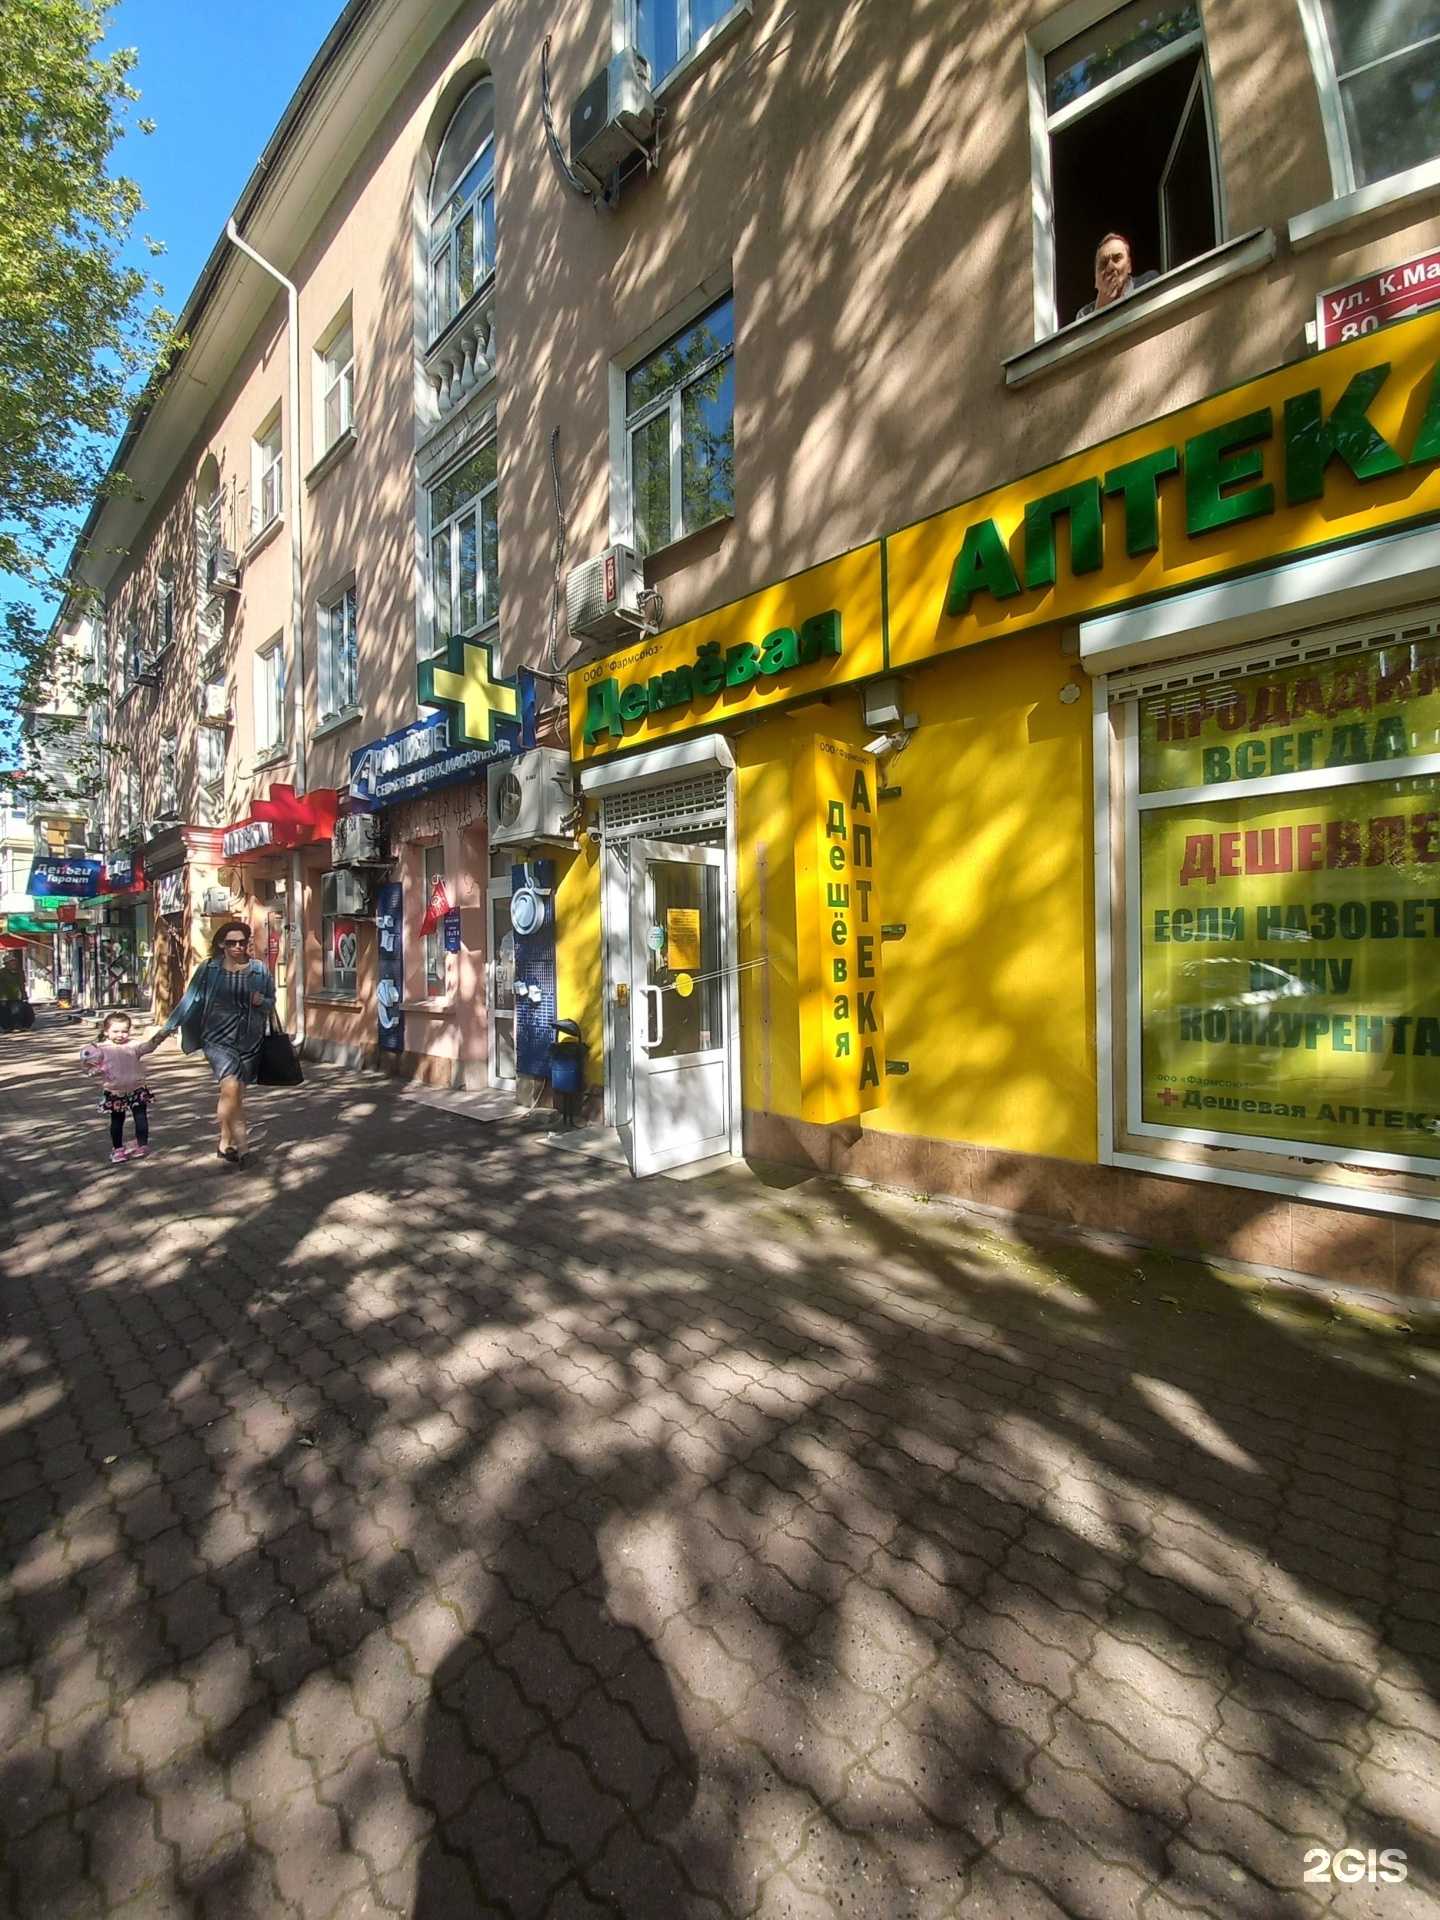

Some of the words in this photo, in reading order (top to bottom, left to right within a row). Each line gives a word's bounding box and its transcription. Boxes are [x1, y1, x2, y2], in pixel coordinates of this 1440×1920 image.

[1331, 290, 1371, 320] ул.
[583, 664, 604, 682] ООО
[583, 608, 842, 746] Дешёвая
[1203, 715, 1410, 785] ВСЕГДА
[1179, 811, 1440, 886] ДЕШЕВЛЕ
[825, 799, 850, 1058] Дешёвая
[850, 768, 880, 1092] АПТЕКА
[1154, 905, 1245, 942] ЕСЛИ
[1183, 1089, 1307, 1119] Дешевая
